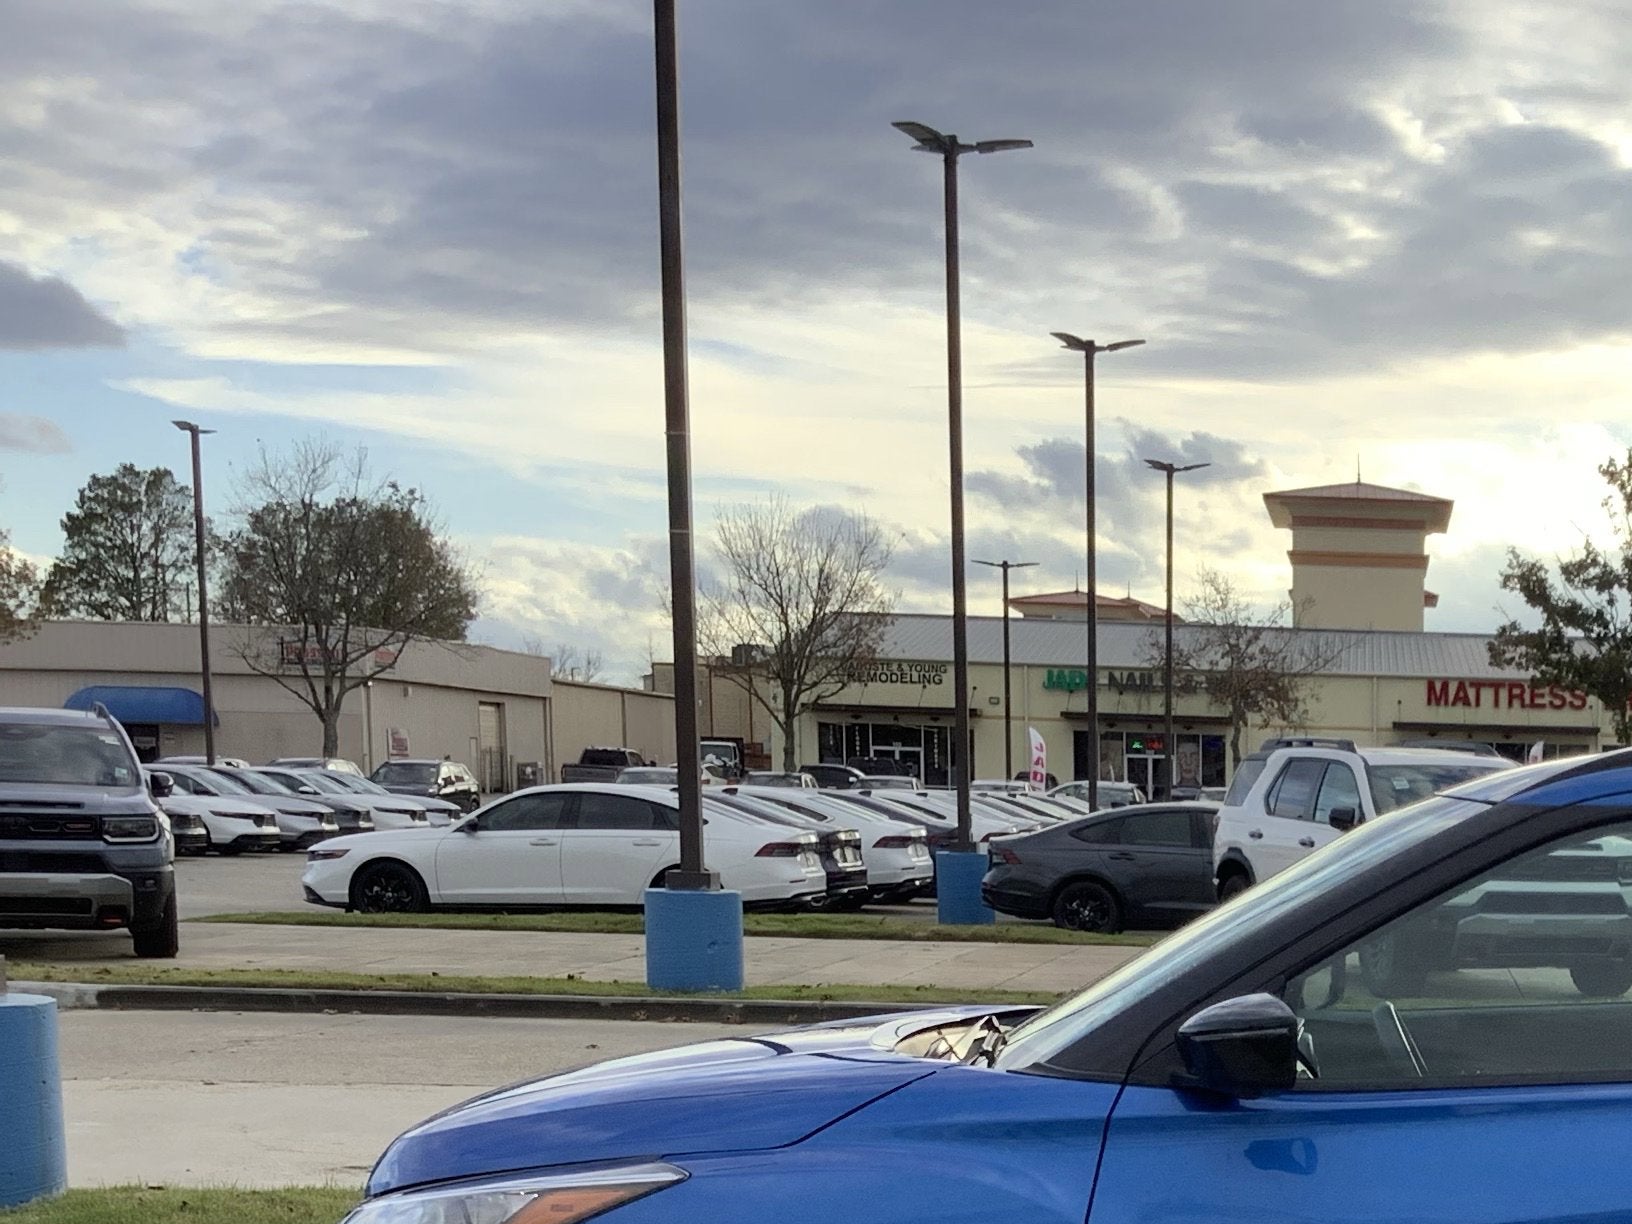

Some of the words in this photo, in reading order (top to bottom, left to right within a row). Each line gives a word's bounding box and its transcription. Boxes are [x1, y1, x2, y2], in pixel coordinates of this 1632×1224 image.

[907, 663, 947, 674] YOUNG
[847, 672, 943, 685] REMODELING
[1043, 669, 1101, 691] JAD
[1426, 680, 1587, 710] MATTRESS
